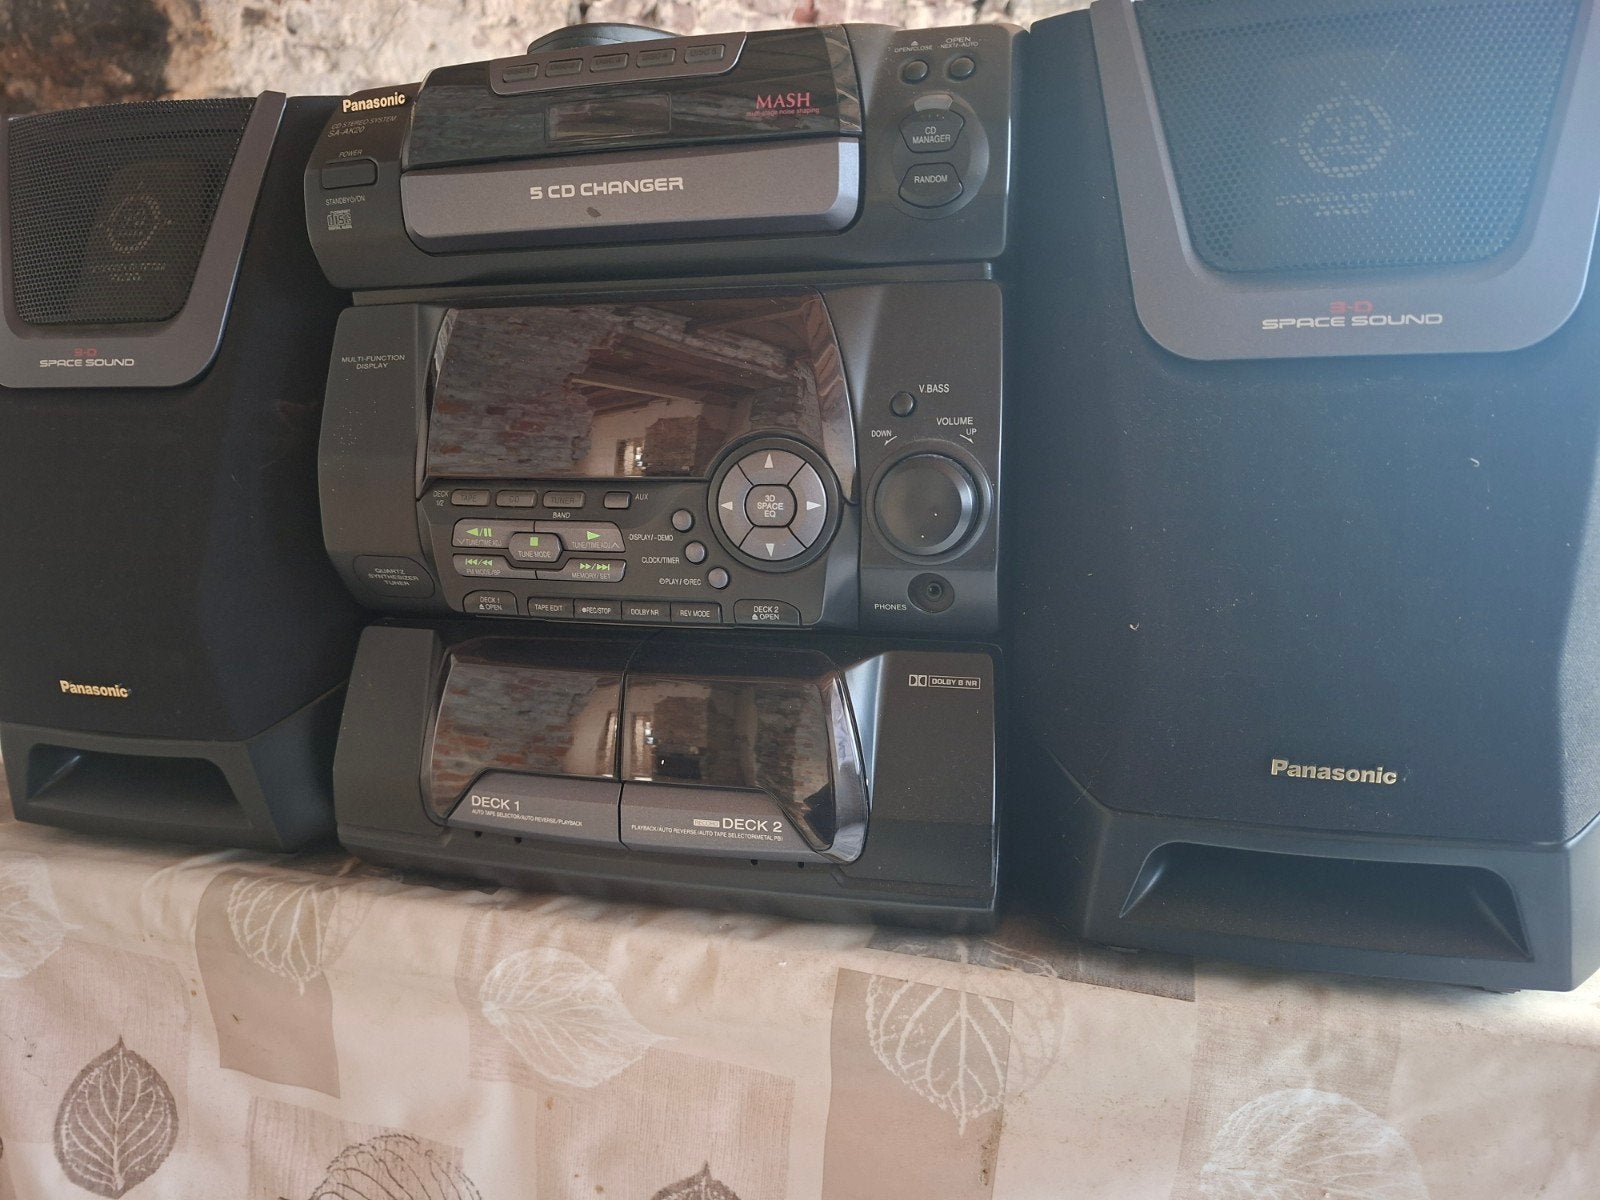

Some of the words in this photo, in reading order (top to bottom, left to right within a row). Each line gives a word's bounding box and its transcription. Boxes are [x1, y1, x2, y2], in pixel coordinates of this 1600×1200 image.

[945, 36, 971, 44] OPEN
[342, 91, 406, 113] Panasonic
[756, 91, 811, 110] MASH
[924, 126, 937, 135] CD
[912, 134, 951, 144] MANAGER
[338, 149, 363, 158] POWER
[913, 174, 948, 184] RANDOM
[529, 186, 543, 200] 5
[547, 184, 576, 198] CD
[580, 176, 684, 196] CHANGER
[1330, 300, 1374, 314] 3-D
[1262, 316, 1346, 330] SPACE
[1351, 313, 1443, 327] SOUND
[39, 359, 83, 368] SPACE
[85, 358, 135, 367] SOUND
[341, 354, 406, 363] MULTI-FUNCTION
[356, 362, 388, 370] DISPLAY
[919, 383, 950, 393] V.BASS
[936, 417, 974, 426] VOLUME
[871, 429, 892, 437] DOWN
[966, 428, 977, 436] UP
[433, 490, 449, 498] DECK
[765, 494, 776, 502] 3D
[551, 496, 575, 504] TUNER
[757, 501, 784, 510] SPACE
[552, 511, 571, 519] BAND
[764, 510, 776, 518] EQ
[641, 556, 680, 564] CLOCK/TIMER
[480, 596, 496, 604] DECK
[534, 603, 549, 611] TAPE
[549, 604, 563, 612] EDIT
[753, 605, 772, 613] DECK
[874, 603, 907, 611] PHONES
[630, 608, 649, 616] DOLBY
[680, 609, 692, 617] REV
[692, 609, 710, 618] MODE
[931, 677, 956, 686] DOLBY
[957, 678, 964, 686] B
[965, 679, 978, 687] NR
[59, 679, 129, 698] Panasonic
[1270, 758, 1398, 785] Panasonic
[471, 795, 511, 811] DECK
[513, 800, 520, 811] 1
[722, 817, 769, 832] DECK
[772, 821, 783, 833] 2
